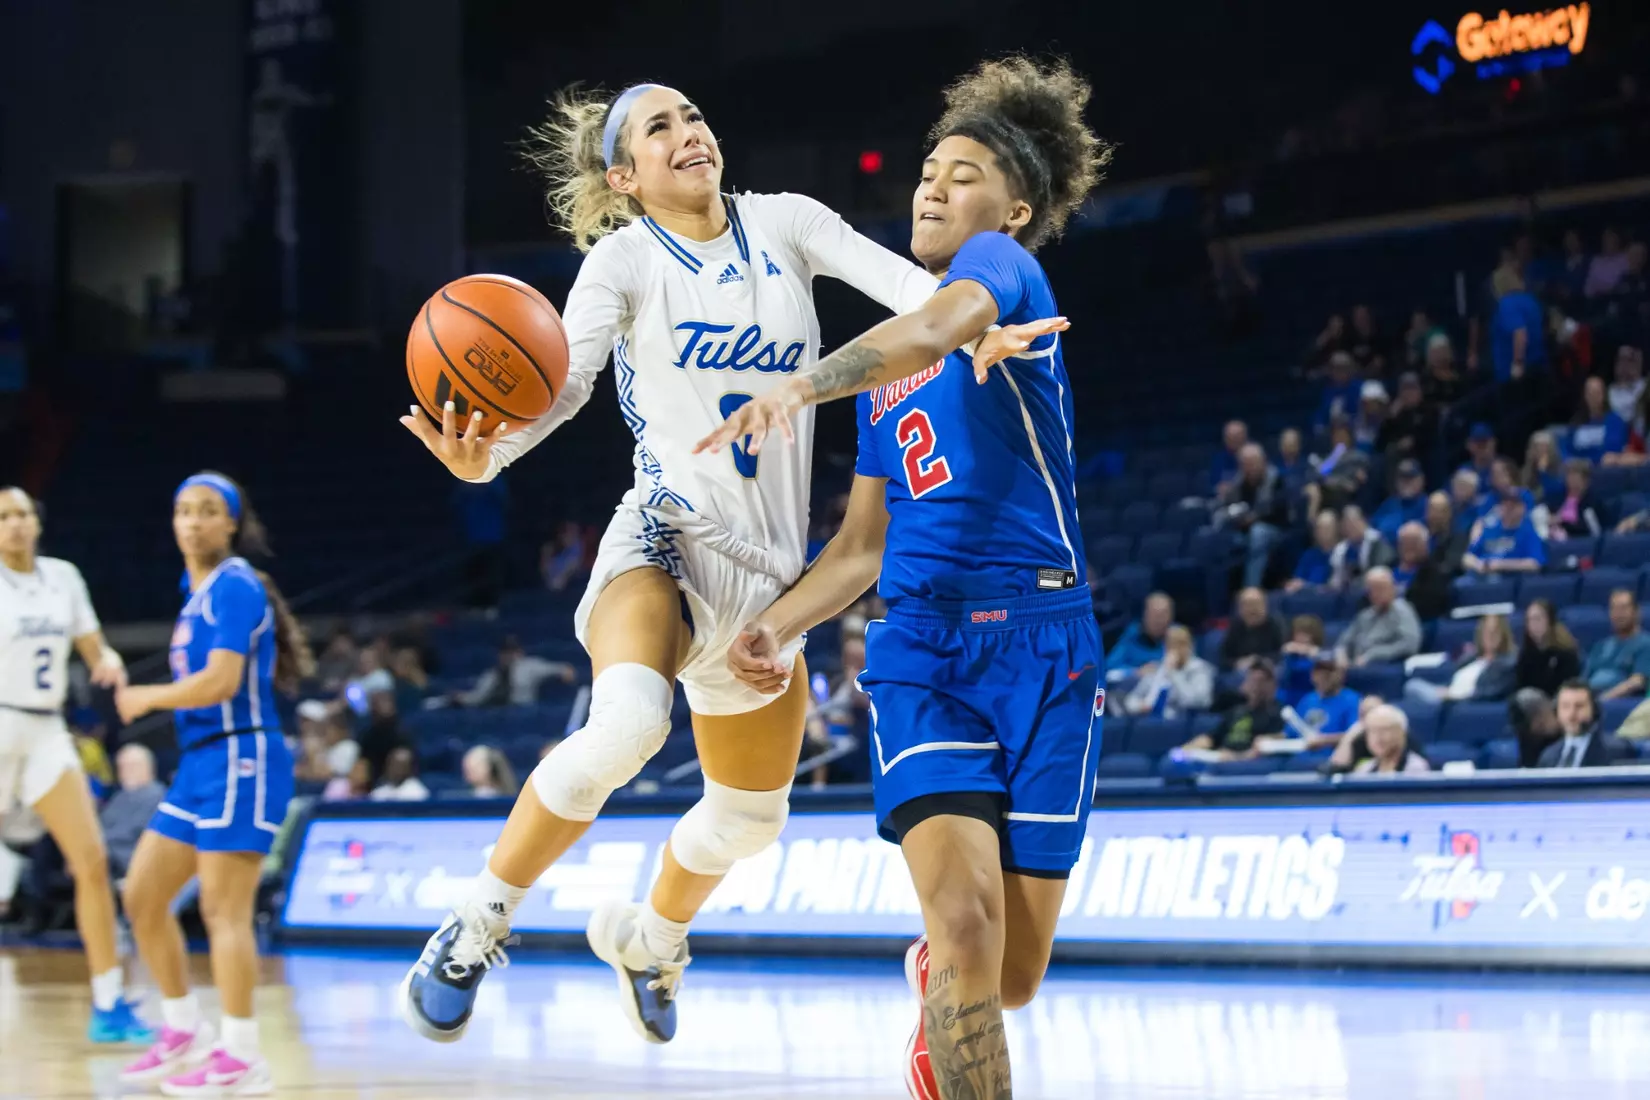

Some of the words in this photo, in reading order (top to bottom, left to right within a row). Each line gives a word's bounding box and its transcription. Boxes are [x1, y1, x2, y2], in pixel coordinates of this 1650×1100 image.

[1456, 2, 1591, 62] Gateway
[716, 274, 745, 285] adidas
[464, 347, 518, 397] PRO
[672, 320, 806, 374] Tulsa
[896, 407, 953, 501] 2
[1066, 576, 1074, 585] M
[971, 609, 1008, 623] SMU
[35, 647, 52, 690] 2
[1084, 834, 1345, 920] ATHLETICS
